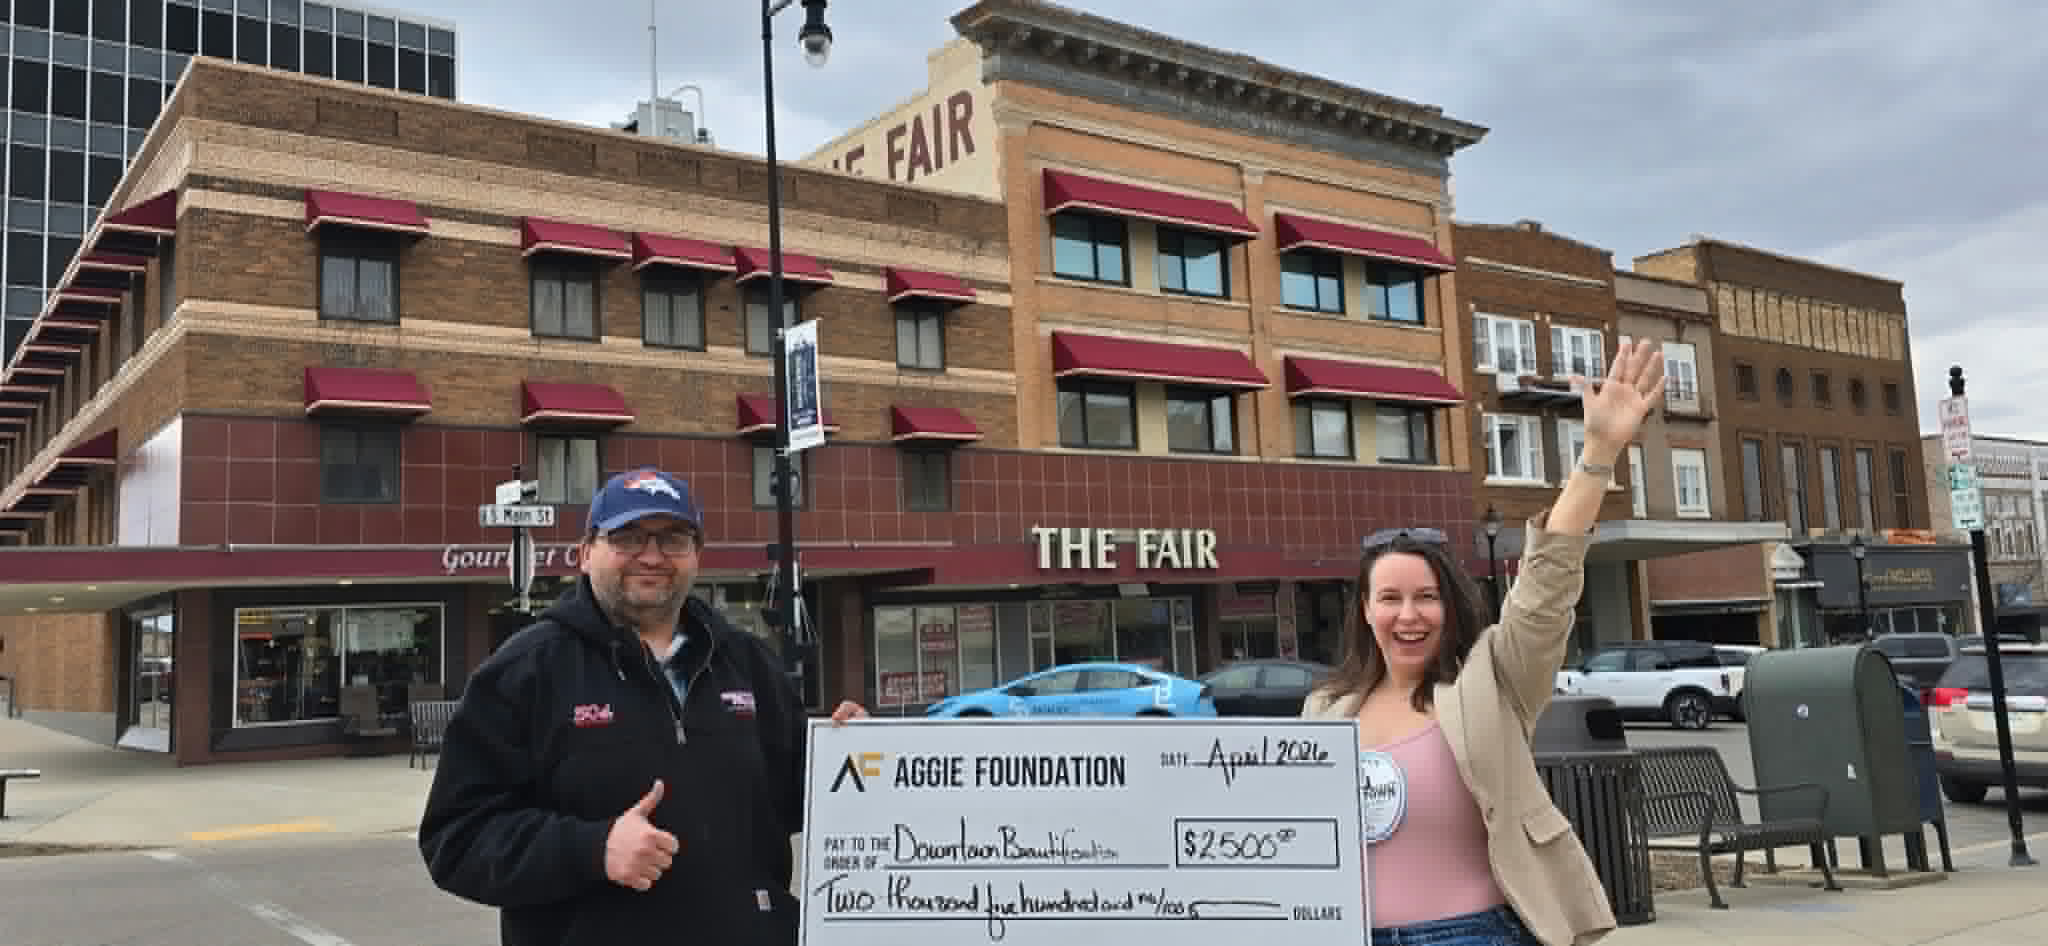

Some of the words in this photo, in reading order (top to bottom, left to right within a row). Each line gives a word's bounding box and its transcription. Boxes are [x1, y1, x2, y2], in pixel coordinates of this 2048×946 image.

[887, 90, 975, 183] FAIR
[503, 509, 532, 523] Main
[1032, 527, 1117, 569] THE
[1138, 528, 1220, 569] FAIR
[895, 756, 964, 788] AGGIE
[974, 756, 1126, 788] FOUNDATION
[1208, 736, 1268, 788] April
[824, 837, 845, 851] PAY
[852, 837, 864, 851] TO
[871, 837, 889, 851] THE
[824, 856, 859, 870] ORDER
[864, 856, 877, 870] OF
[813, 873, 875, 913] Two
[887, 874, 979, 912] thousand
[1293, 905, 1342, 921] DOLLARS
